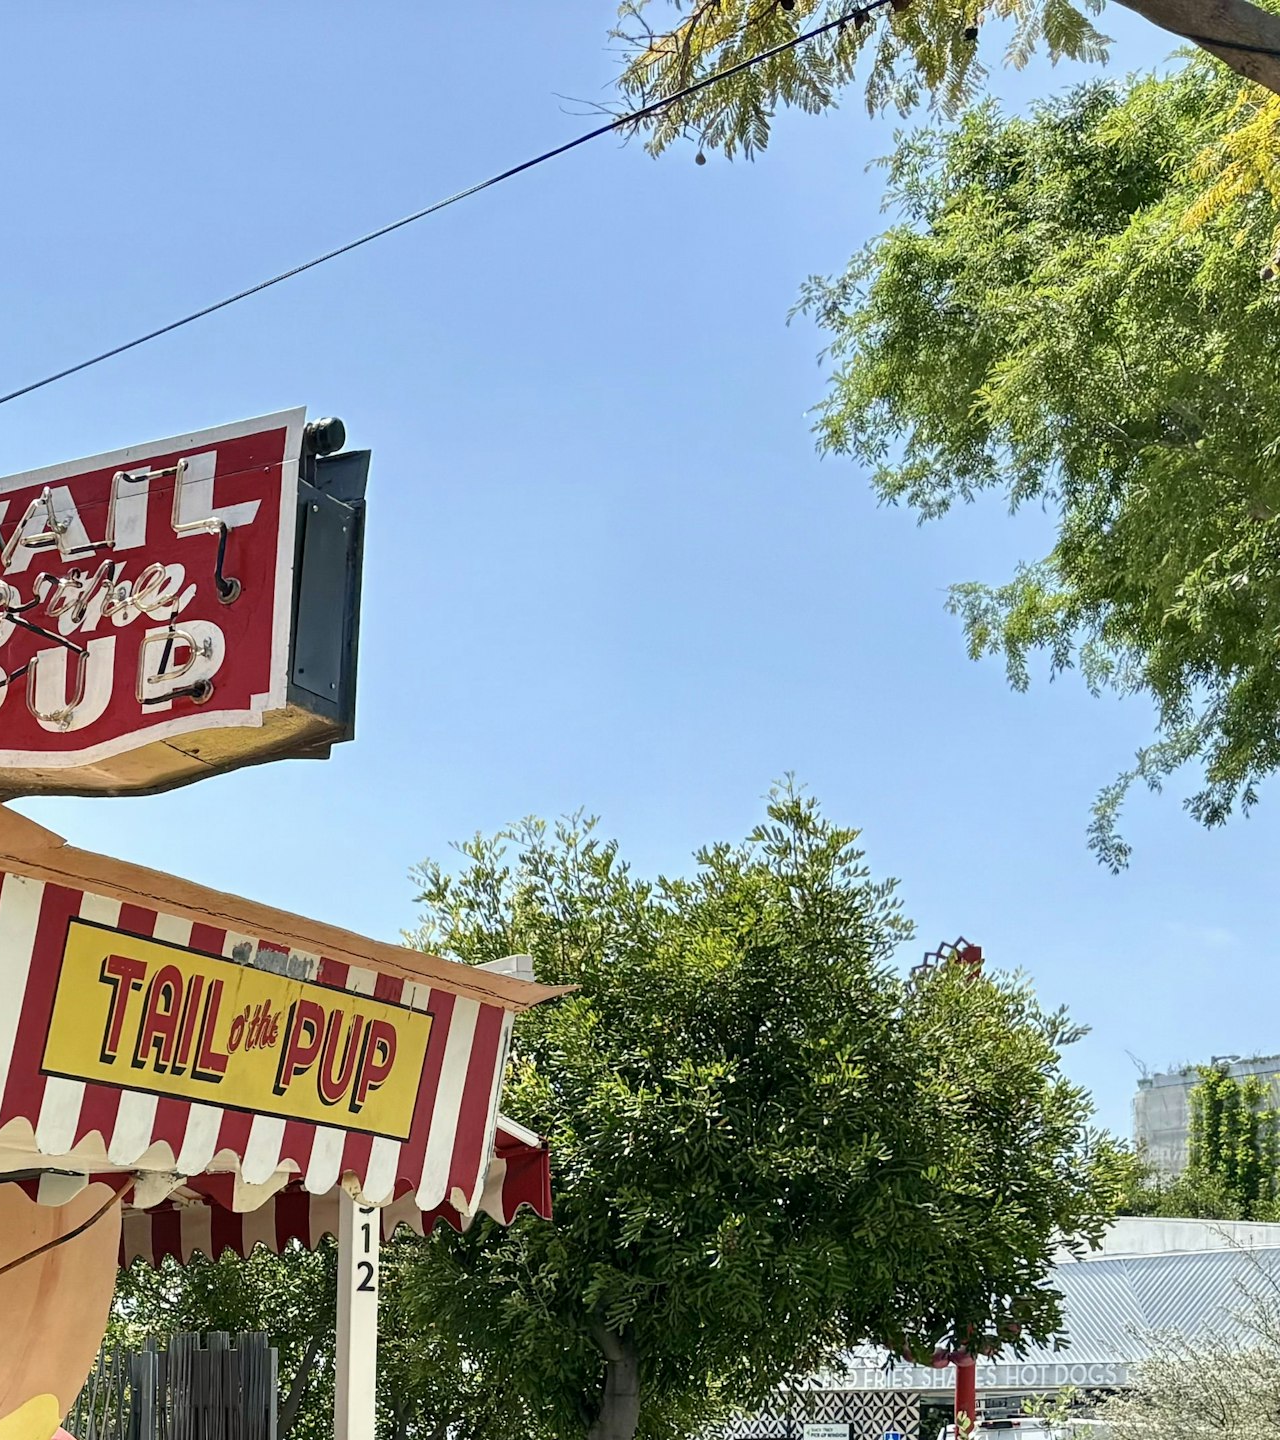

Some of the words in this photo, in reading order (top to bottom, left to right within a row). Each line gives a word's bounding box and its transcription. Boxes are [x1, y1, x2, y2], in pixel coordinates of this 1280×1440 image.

[98, 954, 229, 1083] TAIL
[272, 998, 397, 1114] PUP
[864, 1368, 913, 1387] FRIES
[922, 1366, 997, 1387] SHAES
[1006, 1365, 1051, 1386] HOT
[1056, 1364, 1117, 1386] DOGS
